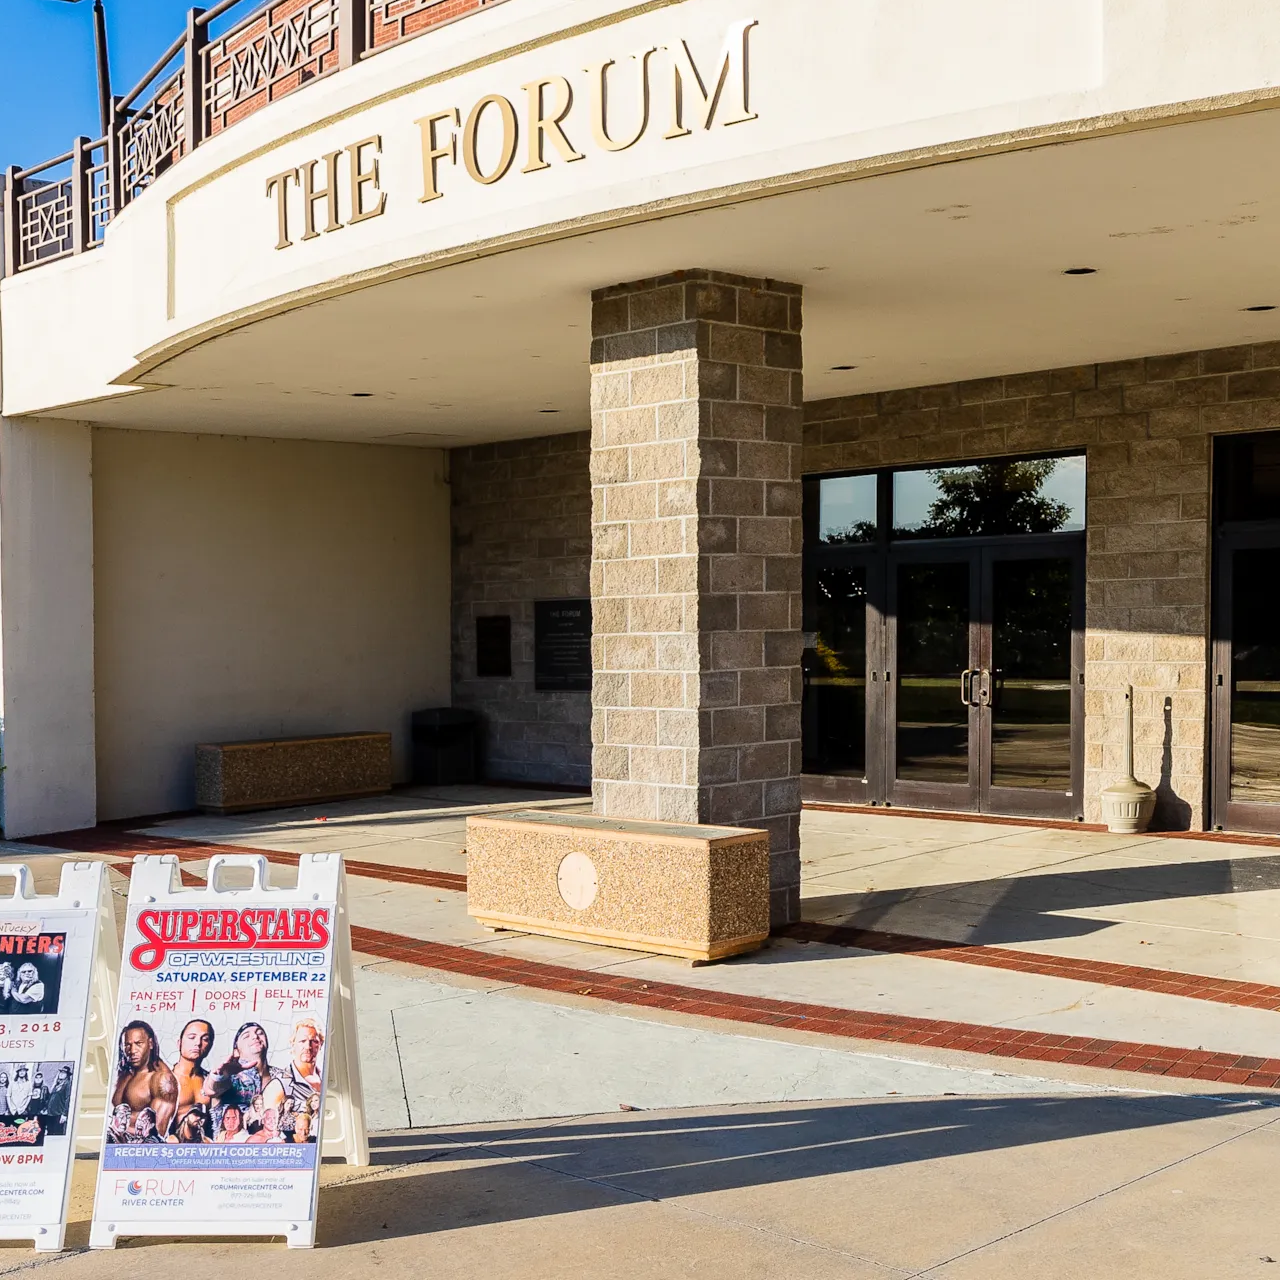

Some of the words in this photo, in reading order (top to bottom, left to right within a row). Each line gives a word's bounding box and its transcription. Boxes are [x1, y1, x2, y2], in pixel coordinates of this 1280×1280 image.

[265, 134, 388, 251] THE
[414, 20, 759, 204] FORUM
[130, 908, 330, 972] SUPERSTARS
[170, 953, 199, 966] OF
[201, 952, 324, 966] WRESTLING
[156, 972, 227, 983] SATURDAY,
[230, 972, 307, 982] SEPTEMBER
[311, 973, 326, 982] 22
[130, 991, 153, 1001] FAN
[156, 991, 184, 1000] FEST
[205, 991, 246, 1000] DOORS
[265, 989, 293, 998] BELL
[297, 989, 324, 998] TIME
[159, 1002, 176, 1011] PM
[209, 1001, 216, 1010] 6
[223, 1001, 240, 1010] PM
[277, 1001, 284, 1011] 7
[292, 1000, 309, 1009] PM
[20, 1022, 61, 1033] 2018
[115, 1148, 159, 1157] RECEIVE
[161, 1147, 174, 1158] $5
[176, 1148, 197, 1157] OFF
[199, 1147, 227, 1156] WITH
[229, 1147, 260, 1156] CODE
[17, 1154, 44, 1164] 8PM
[114, 1179, 195, 1196] FORUM
[122, 1199, 147, 1207] RIVER
[149, 1198, 184, 1206] CENTER
